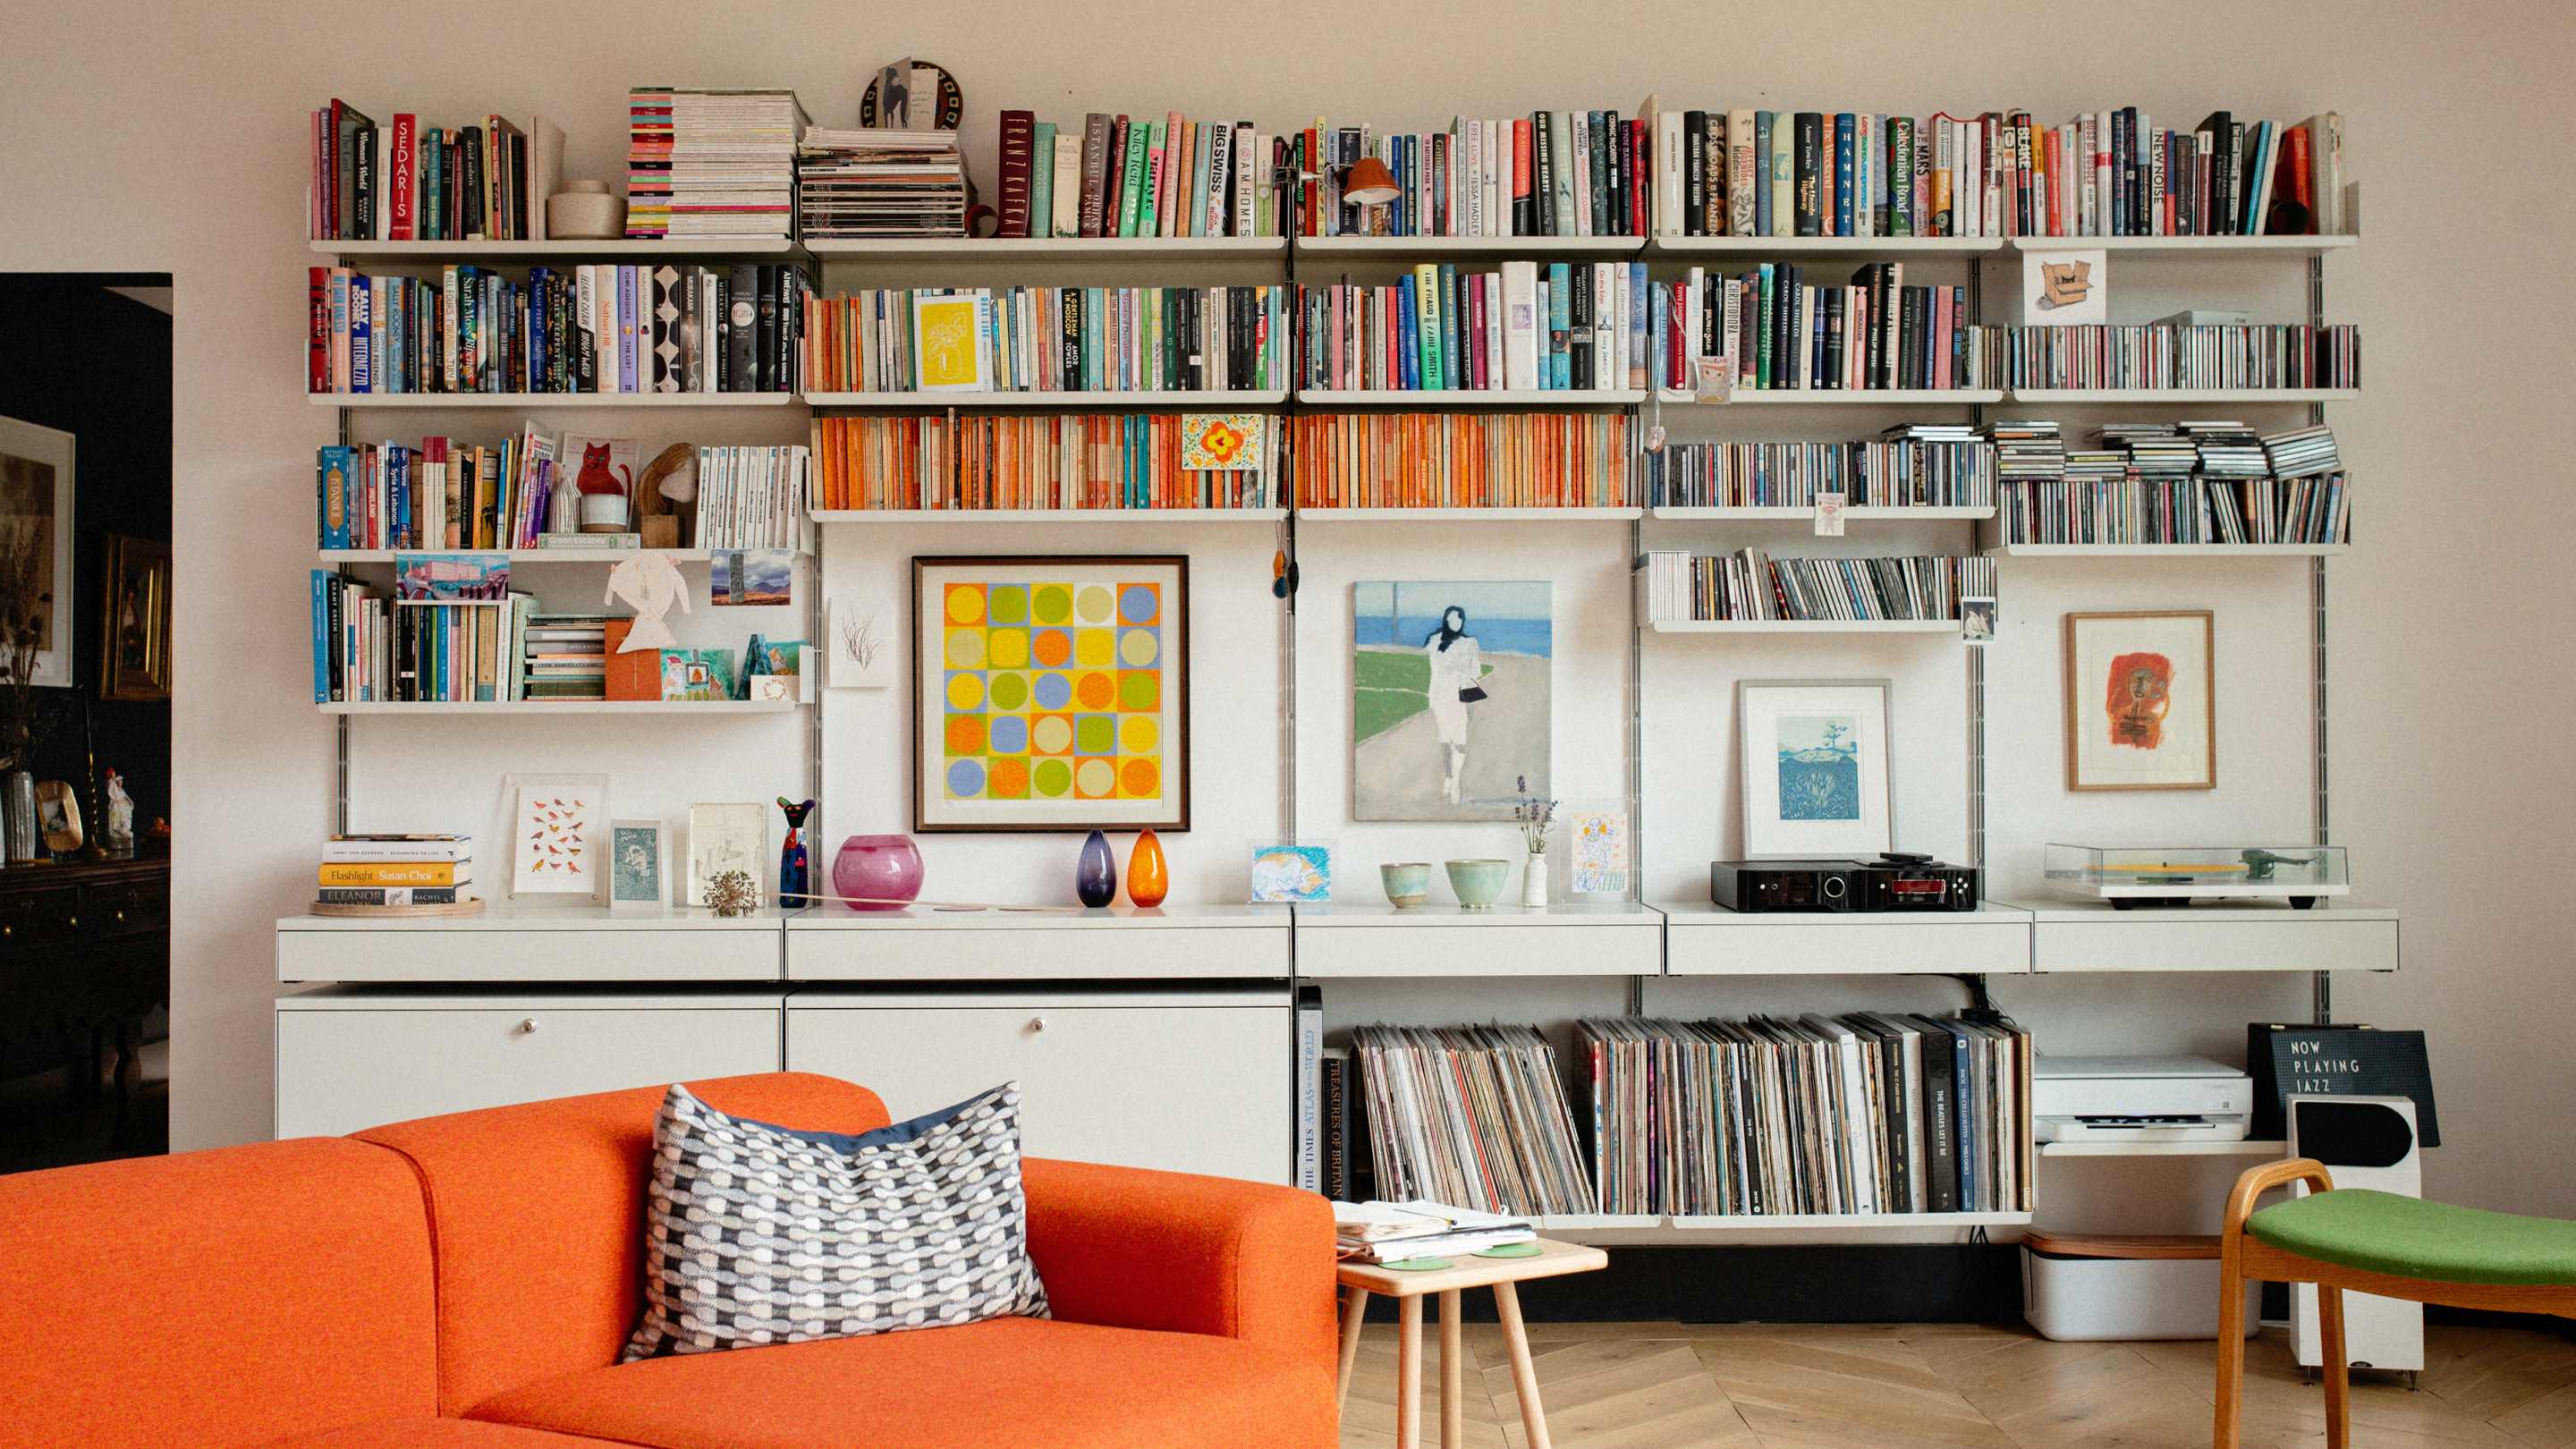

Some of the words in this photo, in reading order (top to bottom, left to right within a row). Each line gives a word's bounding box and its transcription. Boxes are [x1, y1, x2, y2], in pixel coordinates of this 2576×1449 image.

[1119, 121, 1128, 143] Orhan
[1215, 125, 1227, 147] BIG
[1470, 123, 1479, 142] FREE
[1538, 113, 1546, 129] OUR
[1608, 114, 1616, 137] CORMAC
[1824, 120, 1835, 143] The
[2086, 119, 2096, 141] BOSS
[343, 134, 352, 149] The
[359, 131, 369, 165] Woman's
[466, 140, 474, 159] david
[1006, 118, 1027, 167] FRANZ
[1036, 140, 1044, 173] THOMAS
[1089, 123, 1102, 185] ISTANBUL
[1117, 144, 1125, 167] Pamuk
[1470, 145, 1479, 166] LOVE
[1539, 131, 1547, 163] MISSING
[1609, 137, 1617, 165] McCARTHY
[1692, 132, 1700, 158] JONATHAN
[1709, 119, 1718, 182] CROSSROADS
[1896, 122, 1910, 182] Caledonian
[2018, 127, 2031, 169] BLAKE
[2087, 142, 2096, 152] OF
[2154, 134, 2164, 164] NEW
[343, 151, 352, 172] Card
[396, 122, 409, 217] SEDARIS
[1212, 148, 1225, 193] SWISS
[1435, 140, 1445, 174] Griffiths
[1692, 159, 1700, 182] FRANZEN
[1733, 145, 1741, 183] Middlesex
[1740, 145, 1748, 187] EUGENIDES
[1824, 144, 1835, 189] Weekend
[2087, 154, 2097, 185] BOSSES
[359, 165, 369, 191] World
[467, 162, 475, 186] sedaris
[1145, 154, 1161, 210] Martyr!
[1471, 177, 1479, 199] TESSA
[1541, 165, 1549, 192] HEARTS
[2154, 165, 2164, 204] NOISE
[1005, 176, 1026, 225] KAFKA
[1800, 180, 1809, 211] Highway
[1896, 184, 1910, 213] Road
[1083, 194, 1092, 229] PAMUK
[1091, 194, 1100, 229] ORHAN
[1471, 202, 1479, 235] HADLEY
[1709, 192, 1718, 237] FRANZEN
[333, 275, 345, 285] MY
[392, 284, 400, 306] SALLY
[445, 274, 454, 288] ALL
[463, 276, 474, 306] Sarah
[1633, 271, 1642, 291] THE
[333, 287, 346, 304] DARK
[352, 284, 360, 330] ROONEY
[359, 289, 369, 326] SALLY
[445, 290, 454, 315] FOURS
[1726, 283, 1739, 335] CHRISTODORA
[310, 281, 326, 354] TRUST
[334, 305, 346, 334] VANESSA
[435, 294, 443, 332] Burntcoat
[464, 308, 474, 335] Moss
[1634, 292, 1642, 332] SEASIDE
[445, 318, 454, 356] MIRANDA
[352, 337, 368, 386] INTERMEZZO
[445, 358, 454, 378] JULY
[464, 338, 476, 379] Ripeness
[390, 467, 398, 486] Syria
[331, 478, 340, 520] ISTANBUL
[574, 537, 606, 545] Escapes
[331, 870, 373, 883] Flashlight
[379, 870, 406, 881] Susan
[409, 870, 432, 881] Choi
[327, 891, 382, 900] ELEANOR
[1305, 1030, 1315, 1071] WORLD
[2291, 1041, 2320, 1055] NOW
[2294, 1060, 2360, 1073] PLAYING
[1329, 1061, 1342, 1129] TREASURES
[2297, 1079, 2331, 1094] JAZZ
[1305, 1089, 1315, 1124] ATLAS
[1911, 1088, 1919, 1122] MEHLDAU
[1305, 1128, 1314, 1165] TIMES
[1330, 1131, 1341, 1147] OF
[1939, 1148, 1946, 1157] BE
[1331, 1149, 1342, 1198] BRITAIN
